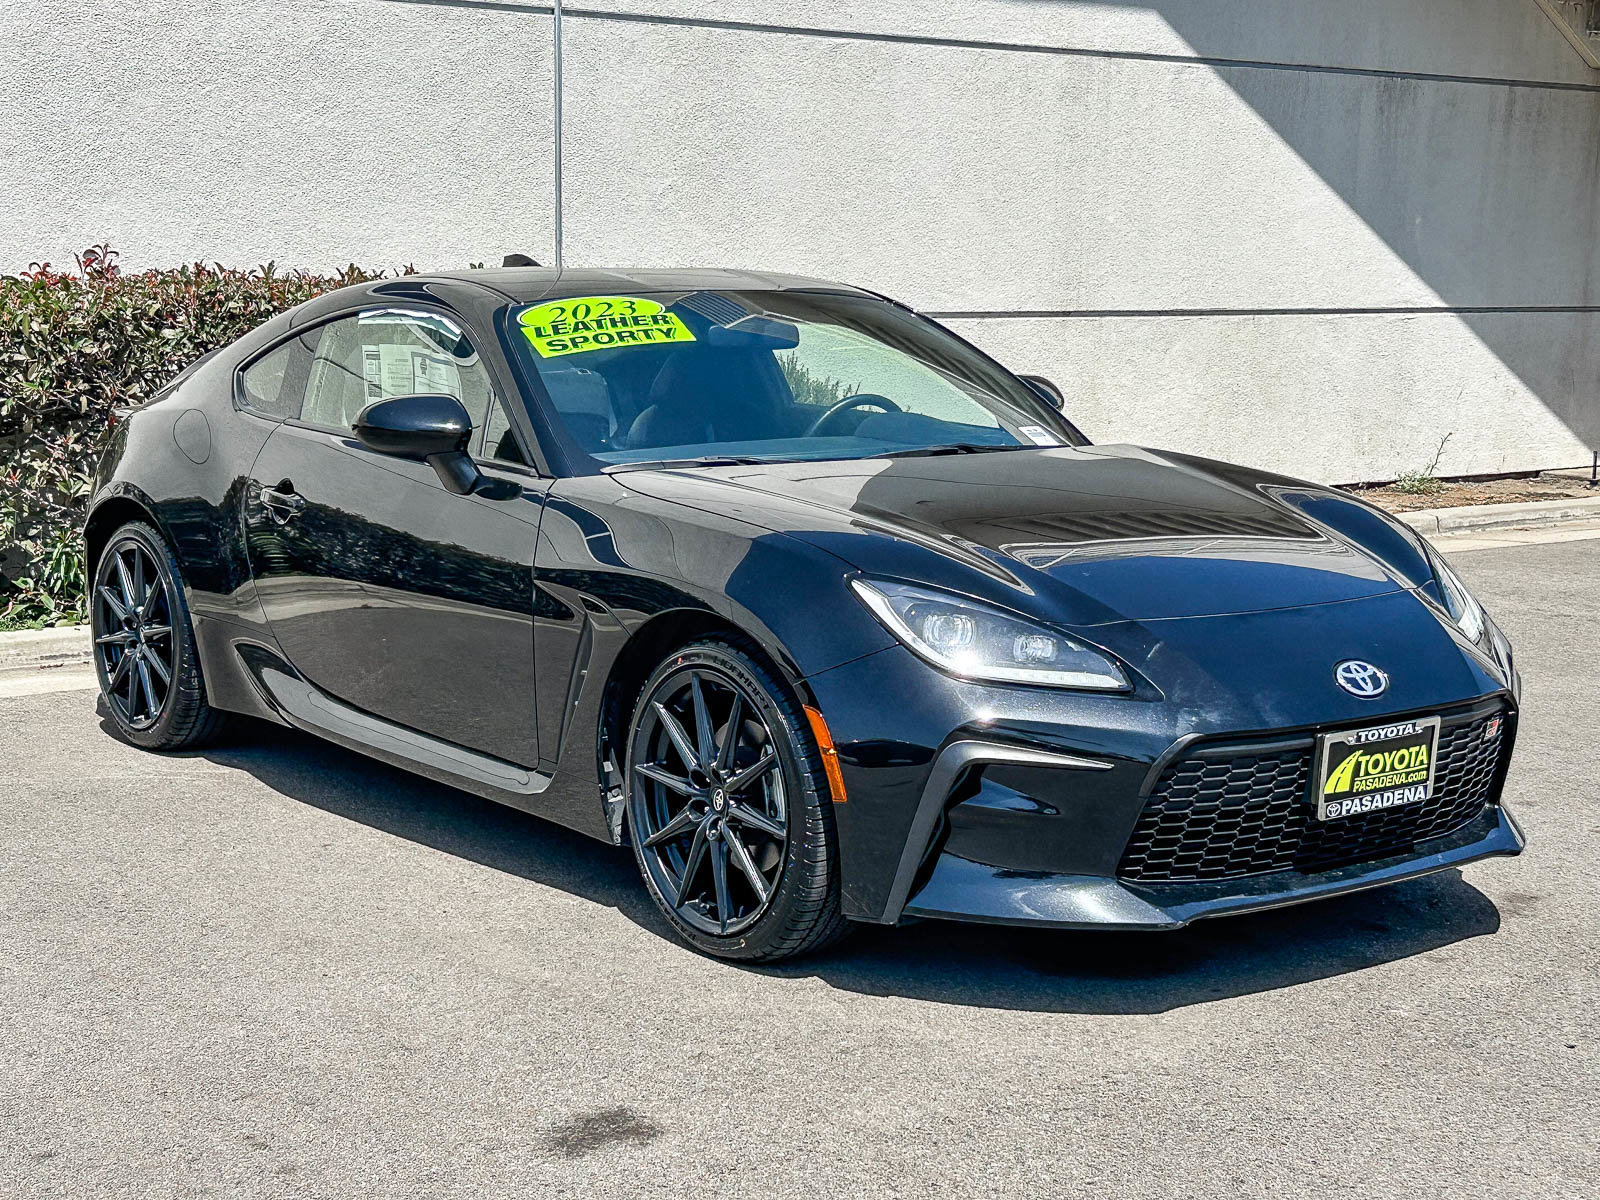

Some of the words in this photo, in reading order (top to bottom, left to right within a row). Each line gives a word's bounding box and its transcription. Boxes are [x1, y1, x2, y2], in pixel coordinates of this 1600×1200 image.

[548, 300, 637, 324] 2023
[533, 313, 674, 339] LEATHER
[546, 327, 677, 352] SPORTY
[1358, 723, 1414, 743] TOYOTA
[1357, 744, 1428, 777] TOYOTA
[1352, 770, 1427, 793] PASADENA.com
[1341, 785, 1426, 815] PASADENA
